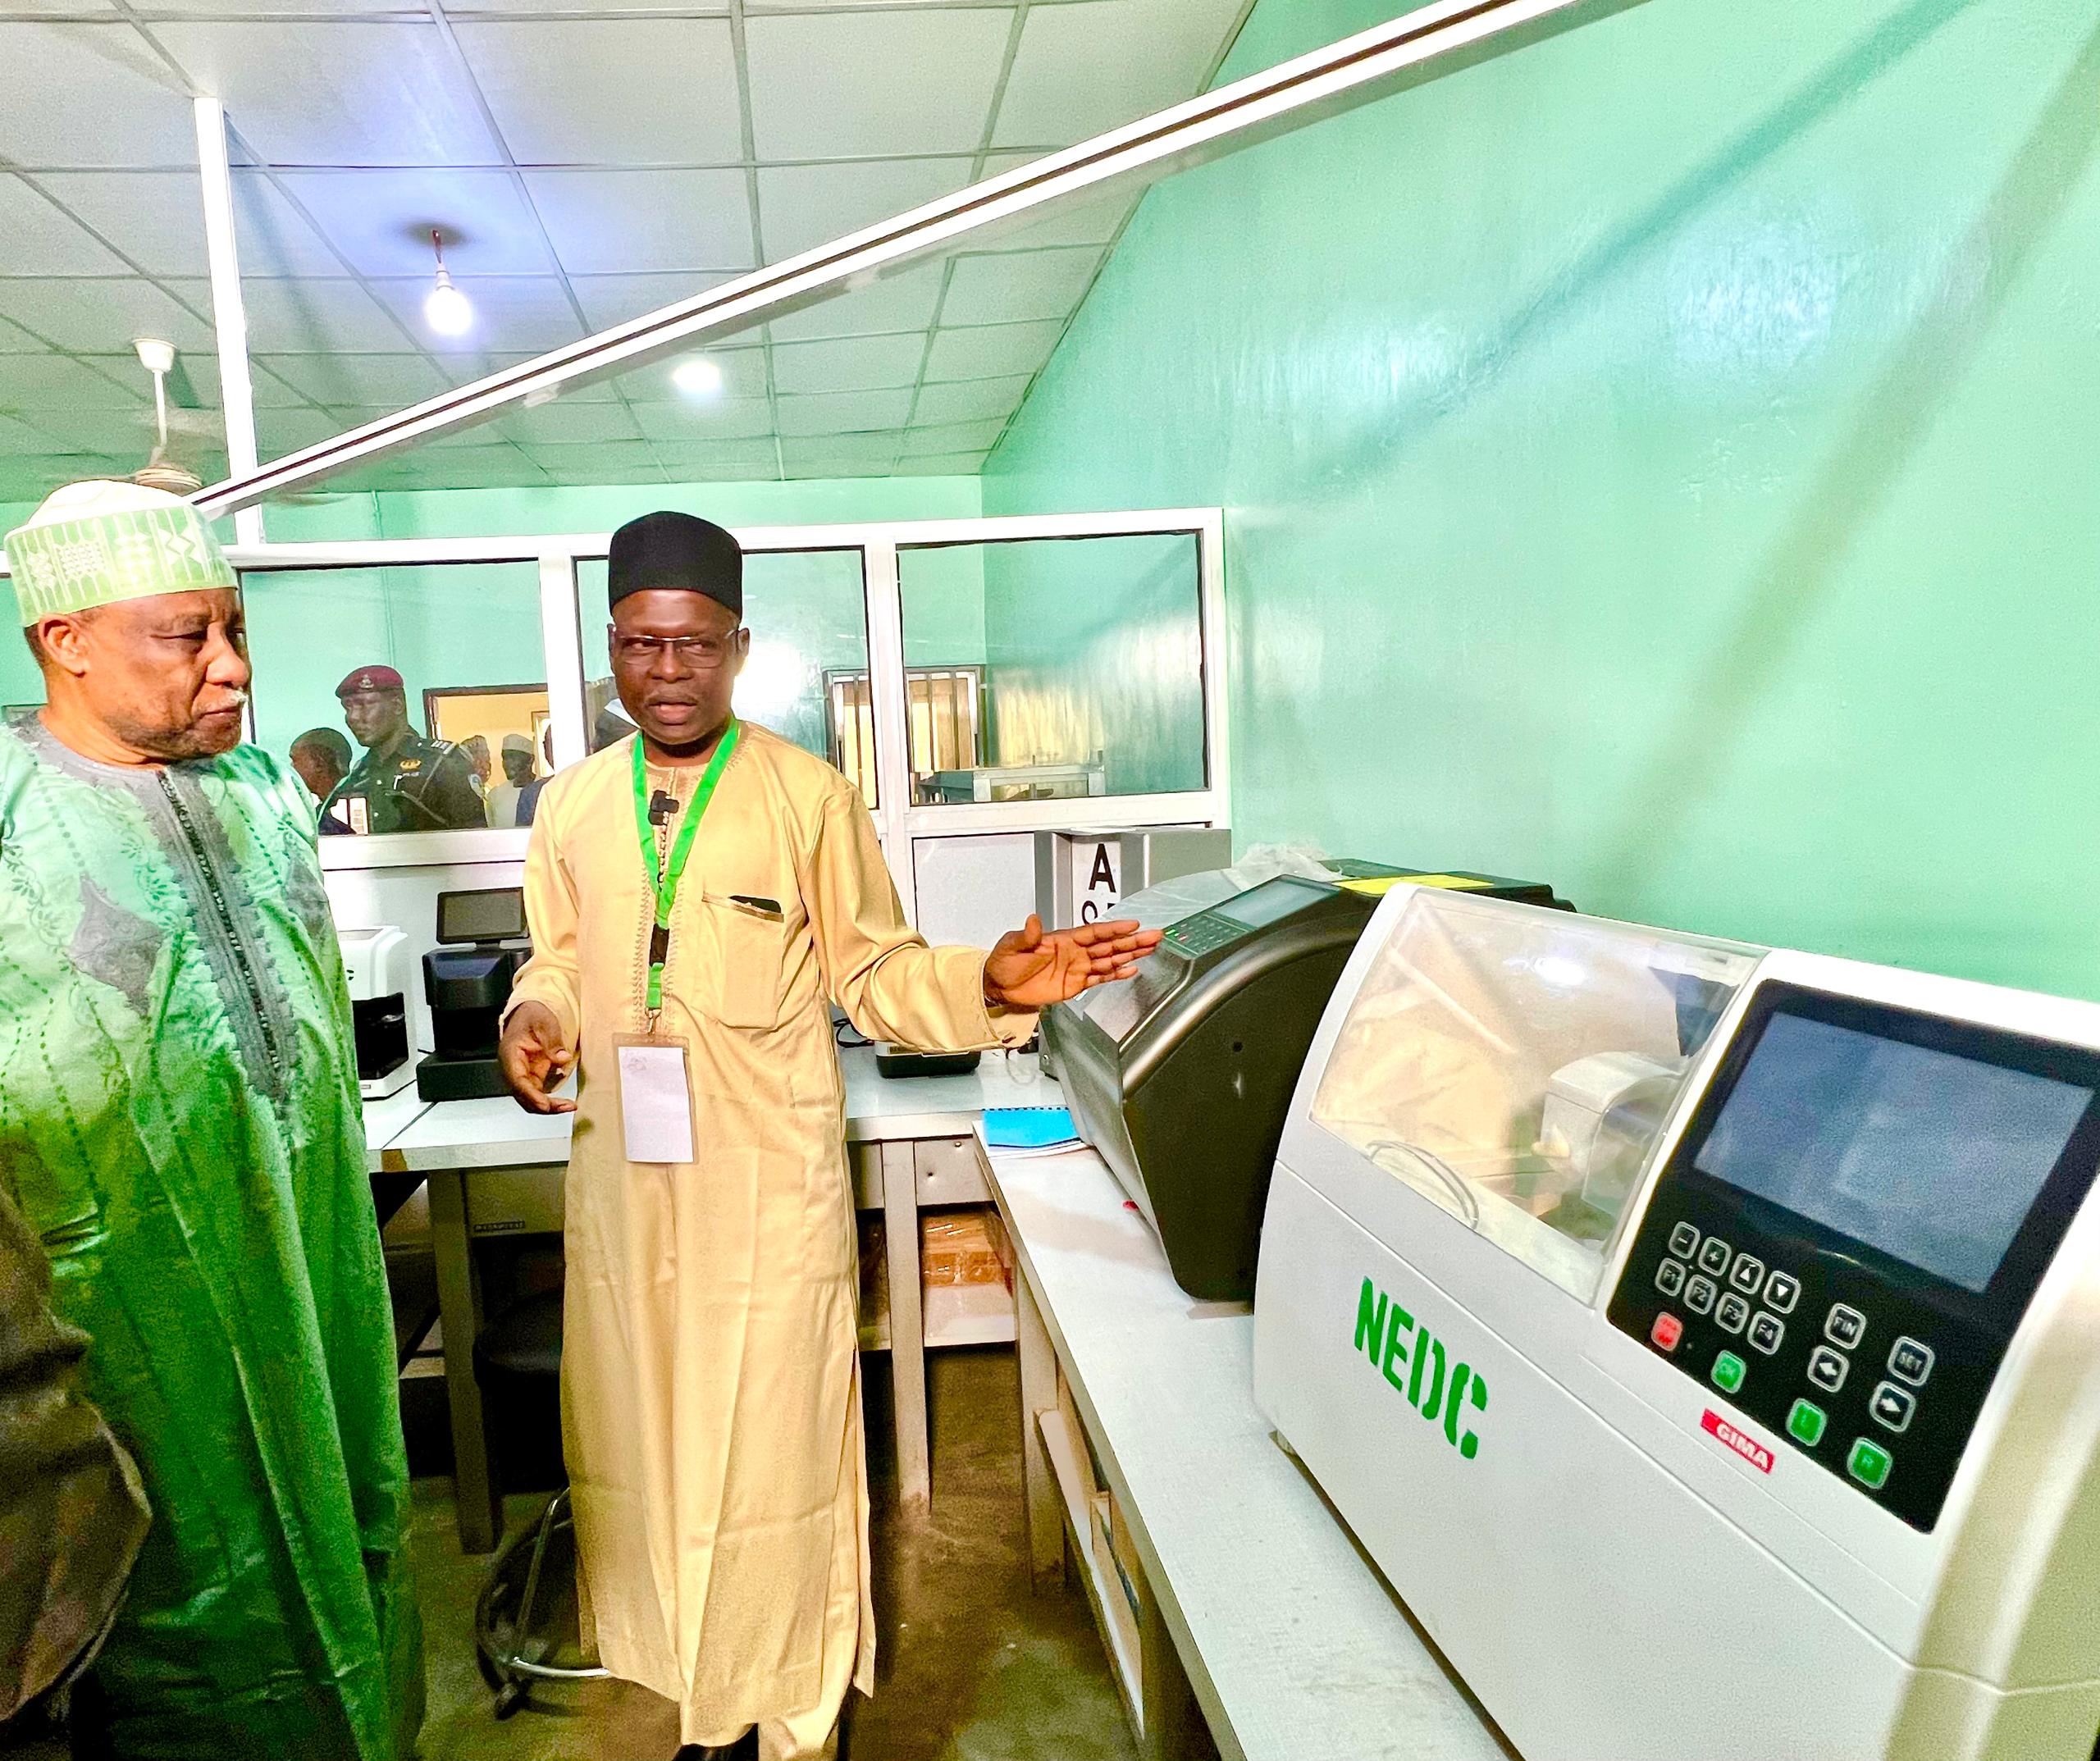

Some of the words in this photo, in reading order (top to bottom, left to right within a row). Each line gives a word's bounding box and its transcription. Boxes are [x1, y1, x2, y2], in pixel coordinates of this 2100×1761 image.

[1088, 843, 1116, 893] A
[1081, 900, 1116, 925] O
[1354, 1275, 1488, 1460] NEDC
